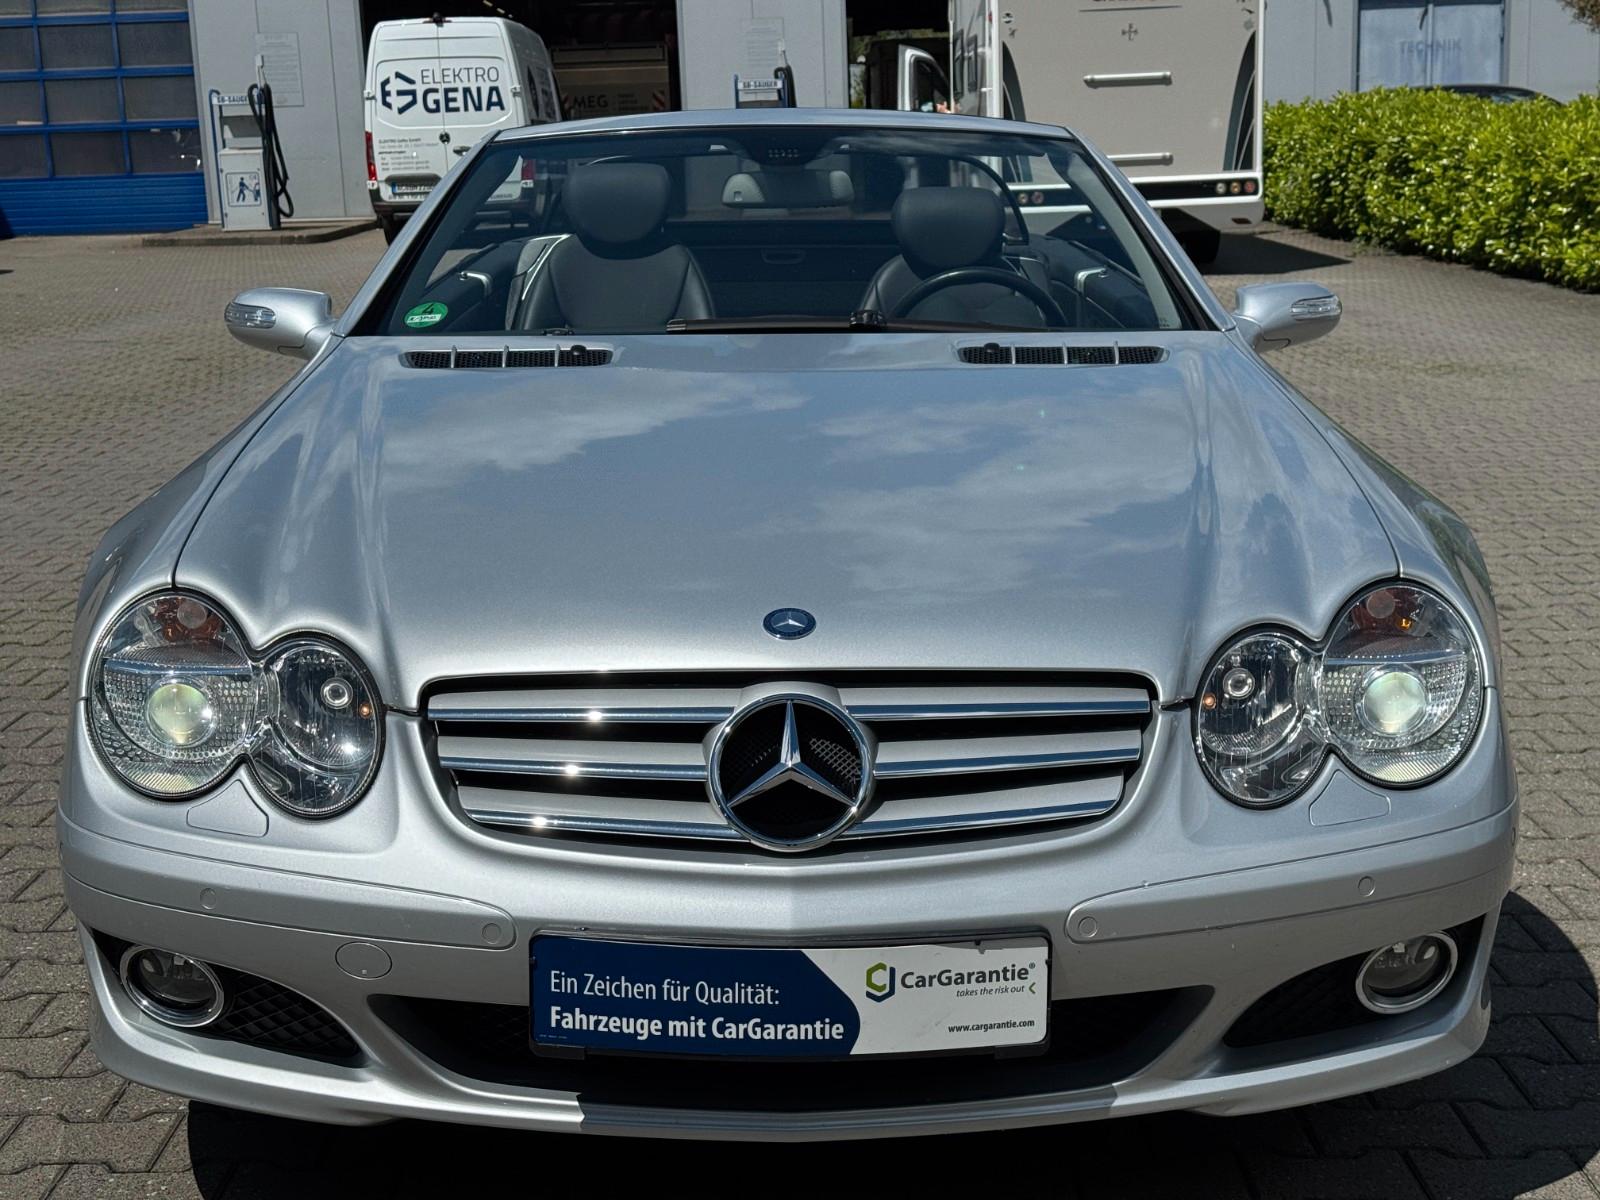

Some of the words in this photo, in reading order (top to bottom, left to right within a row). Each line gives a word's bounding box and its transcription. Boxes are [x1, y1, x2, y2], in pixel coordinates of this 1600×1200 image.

[420, 66, 500, 85] ELEKTRO
[422, 85, 505, 114] GENA
[422, 303, 434, 314] 4
[550, 969, 578, 994] Ein
[583, 973, 657, 1000] Zeichen
[662, 979, 690, 1002] für
[695, 981, 780, 1006] Qualität:
[956, 987, 978, 998] takes
[980, 986, 993, 996] the
[994, 985, 1009, 995] risk
[1010, 985, 1025, 994] out
[550, 1006, 663, 1040] Fahrzeuge
[668, 1015, 706, 1038] mit
[711, 1016, 844, 1040] CarGarantie
[948, 1019, 1035, 1034] www.cargarantie.com
